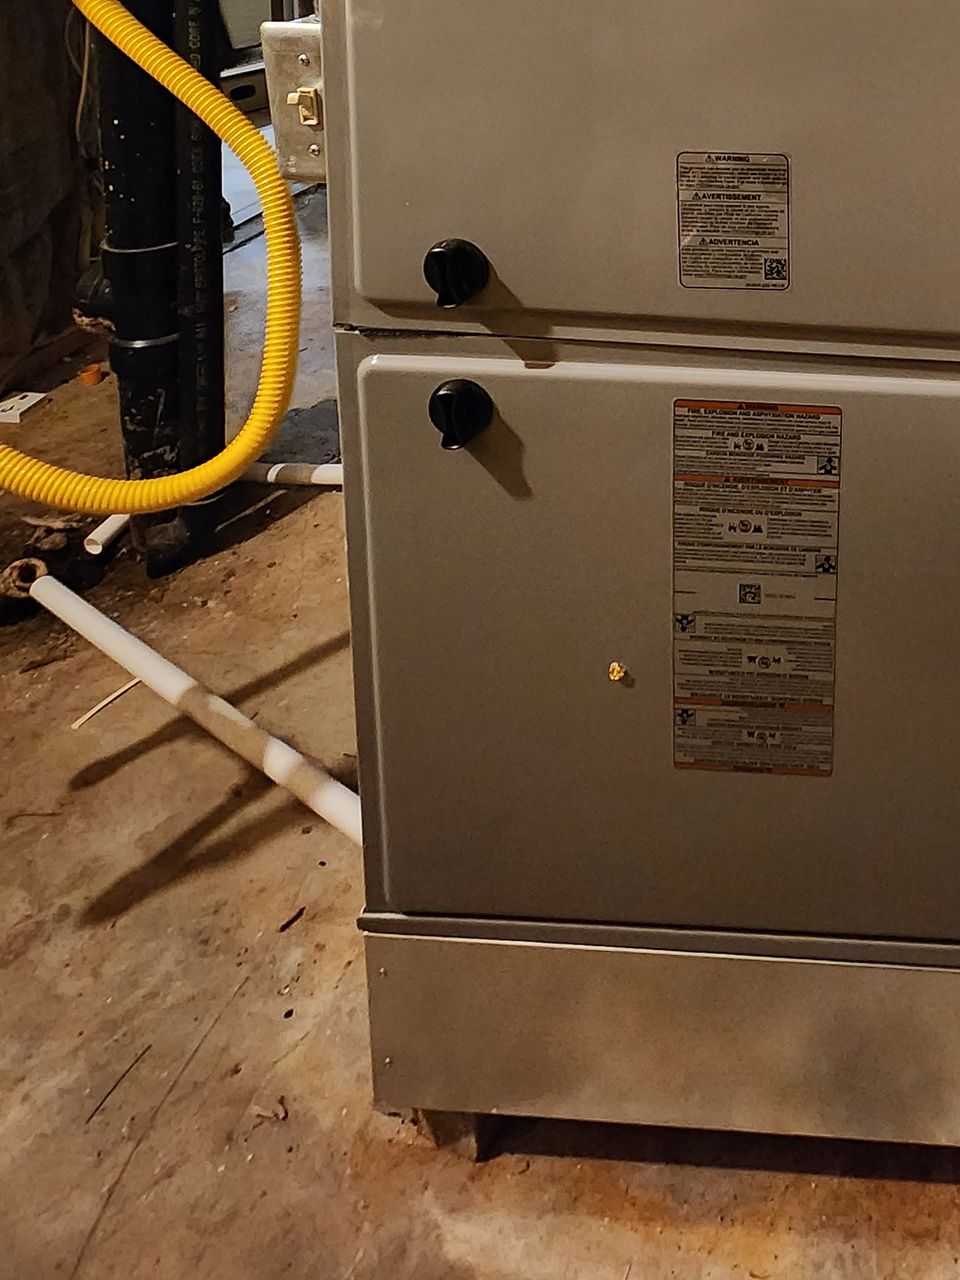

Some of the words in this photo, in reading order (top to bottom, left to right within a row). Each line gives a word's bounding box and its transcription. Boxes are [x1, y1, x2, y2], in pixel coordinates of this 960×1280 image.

[714, 155, 750, 163] WARNING
[702, 192, 762, 201] AVERTISSEMENT
[708, 238, 760, 247] ADVERTENCIA
